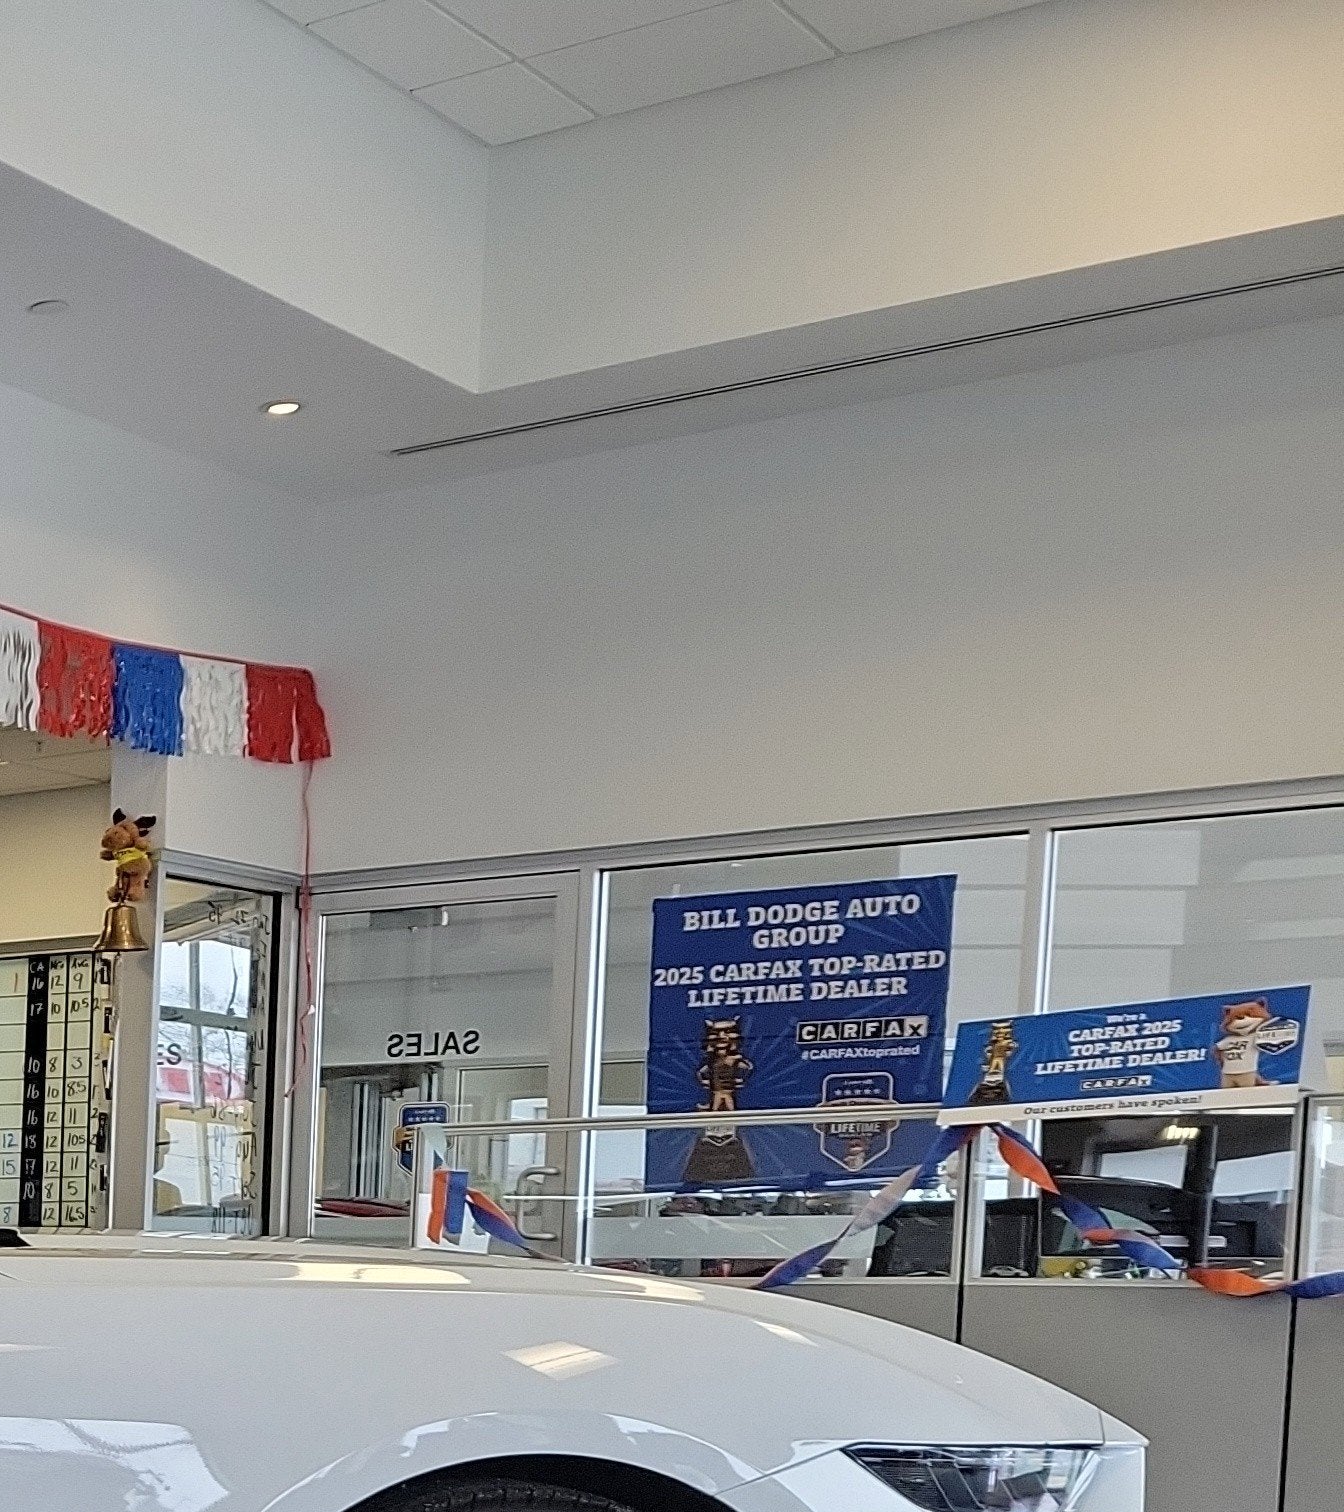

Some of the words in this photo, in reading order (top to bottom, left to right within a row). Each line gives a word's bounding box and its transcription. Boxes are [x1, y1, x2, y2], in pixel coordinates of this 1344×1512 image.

[684, 909, 740, 931] BILL
[748, 901, 839, 927] DODGE
[846, 894, 920, 919] AUTO
[753, 924, 845, 949] GROUP
[654, 966, 704, 987] 2025
[710, 959, 802, 984] CARFAX
[809, 950, 946, 976] TOP-RATED
[50, 975, 64, 989] 12
[73, 973, 83, 989] 9
[688, 983, 804, 1008] LIFETIME
[810, 976, 907, 1001] DEALER
[30, 1003, 44, 1016] 17
[51, 1003, 61, 1015] 10
[799, 1018, 926, 1042] CARFAX
[1068, 1024, 1138, 1042] CARFAX
[1142, 1019, 1183, 1037] 2025
[801, 1045, 920, 1060] #CARFAXtoprated
[1070, 1037, 1170, 1057] TOP-RATED
[27, 1057, 40, 1073] 10
[49, 1057, 57, 1072] 8
[71, 1056, 82, 1069] 3
[1035, 1056, 1123, 1075] LIFETIME
[1127, 1049, 1207, 1068] DEALER!
[27, 1083, 40, 1099] 16
[47, 1086, 59, 1098] 10
[1081, 1075, 1152, 1090] CARFAX
[1024, 1106, 1047, 1115] Our
[1049, 1102, 1114, 1114] customers
[1118, 1099, 1148, 1109] have
[1151, 1095, 1202, 1108] spoken!
[27, 1109, 38, 1125] 16
[47, 1111, 58, 1124] 12
[831, 1122, 882, 1134] LIFETIME
[3, 1133, 18, 1147] 12
[46, 1135, 58, 1149] 12
[2, 1161, 16, 1175] 15
[45, 1160, 58, 1173] 12
[44, 1182, 53, 1198] 8
[67, 1181, 78, 1195] 5
[3, 1206, 11, 1223] 8
[43, 1207, 55, 1220] 12
